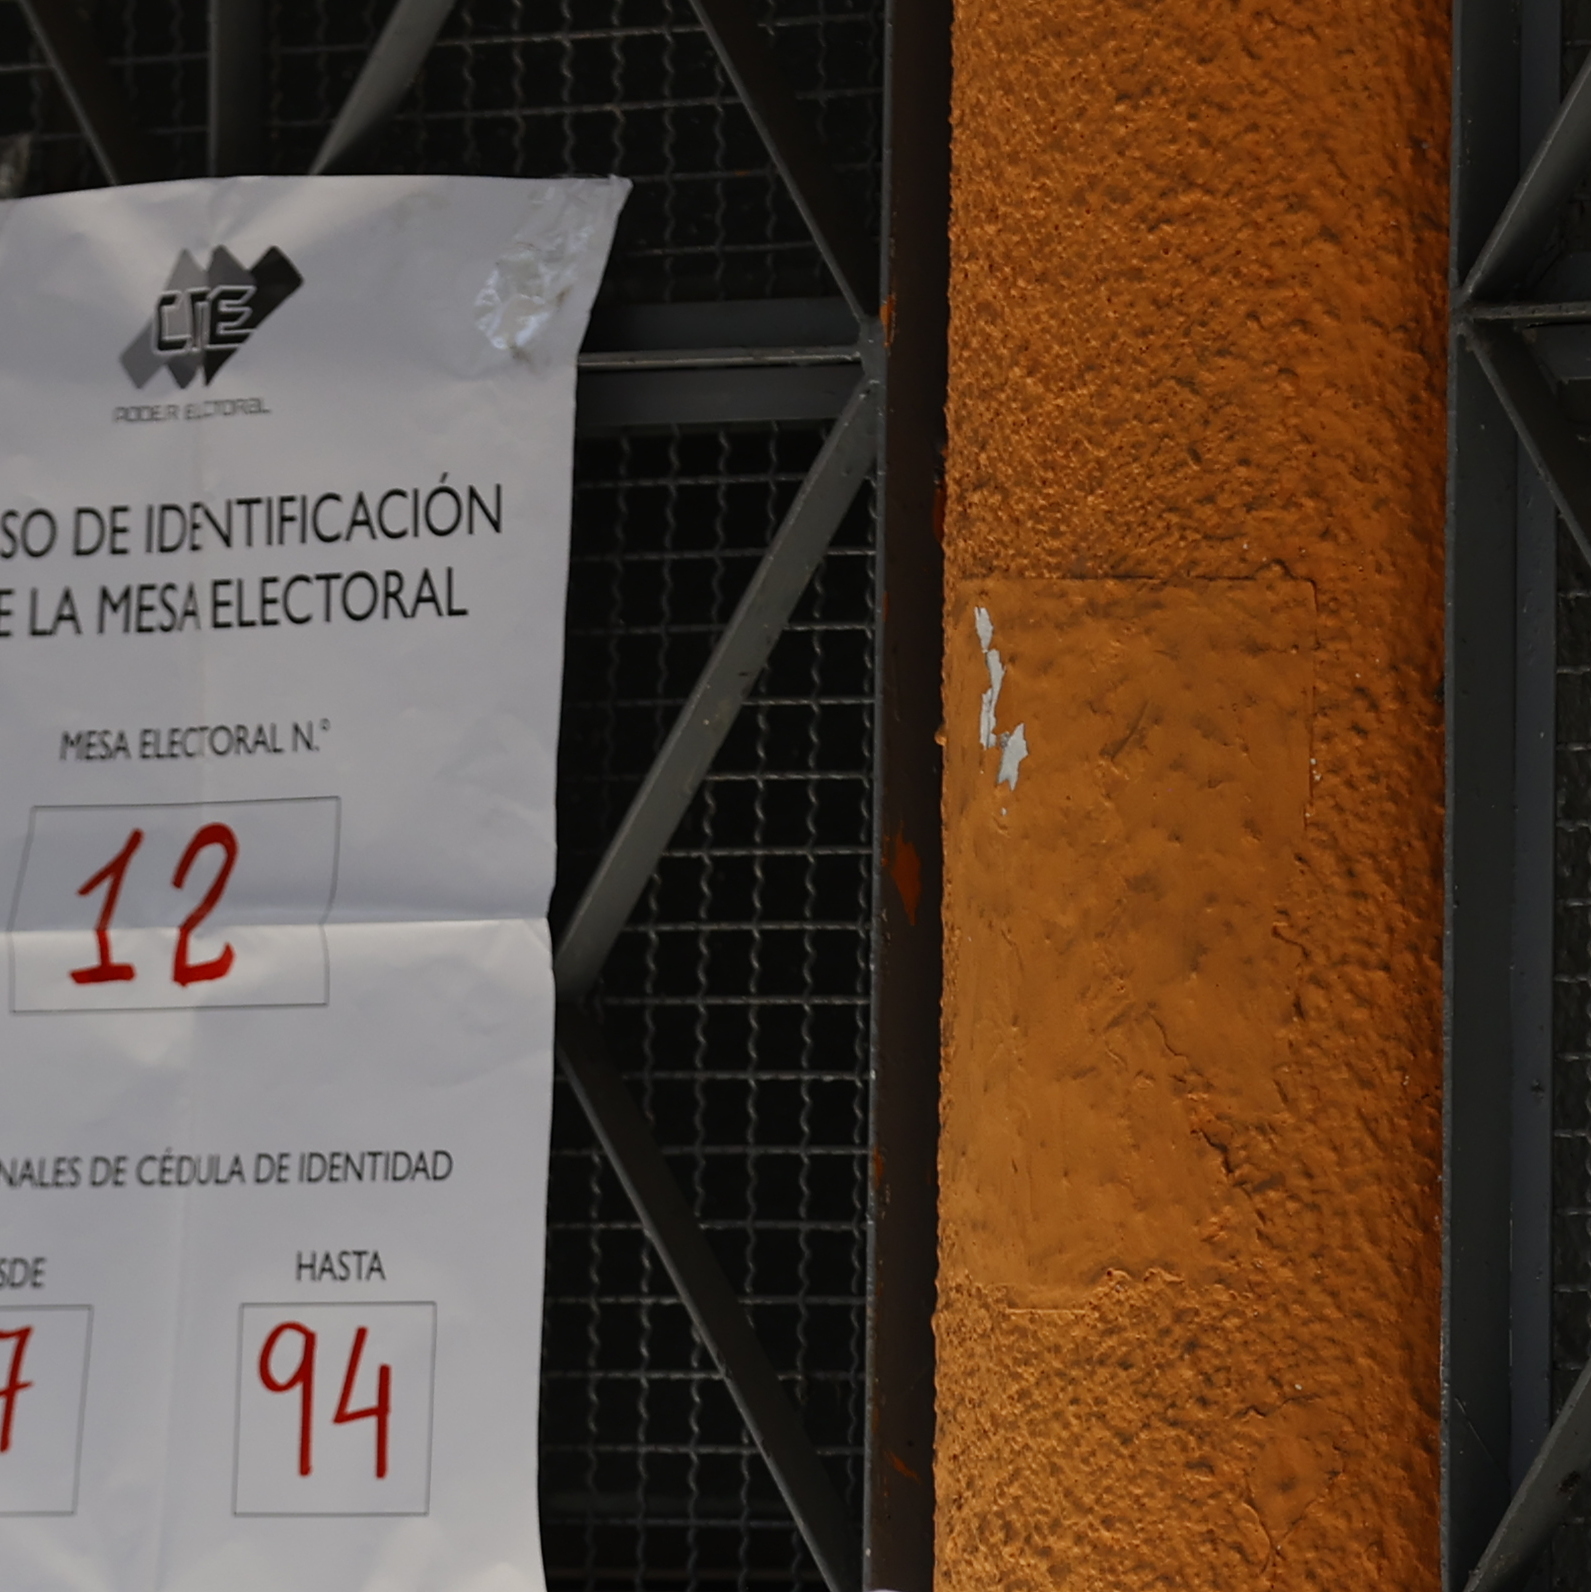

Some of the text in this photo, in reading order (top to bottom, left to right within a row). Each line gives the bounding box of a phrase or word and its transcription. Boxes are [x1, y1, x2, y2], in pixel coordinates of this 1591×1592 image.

[73, 505, 130, 556] DE
[145, 472, 504, 553] IDENTIFICACIÓN
[30, 586, 82, 637] LA
[98, 581, 200, 634] MESA
[212, 566, 469, 630] ELECTORAL
[60, 729, 130, 762] MESA
[139, 725, 284, 760] ELECTORAL
[69, 822, 237, 987] 12
[90, 1156, 127, 1188] DE
[135, 1148, 245, 1187] CÉDULA
[254, 1153, 291, 1184] DE
[298, 1150, 453, 1183] IDENTIDAD
[296, 1250, 386, 1282] HASTA
[258, 1321, 390, 1479] 94
